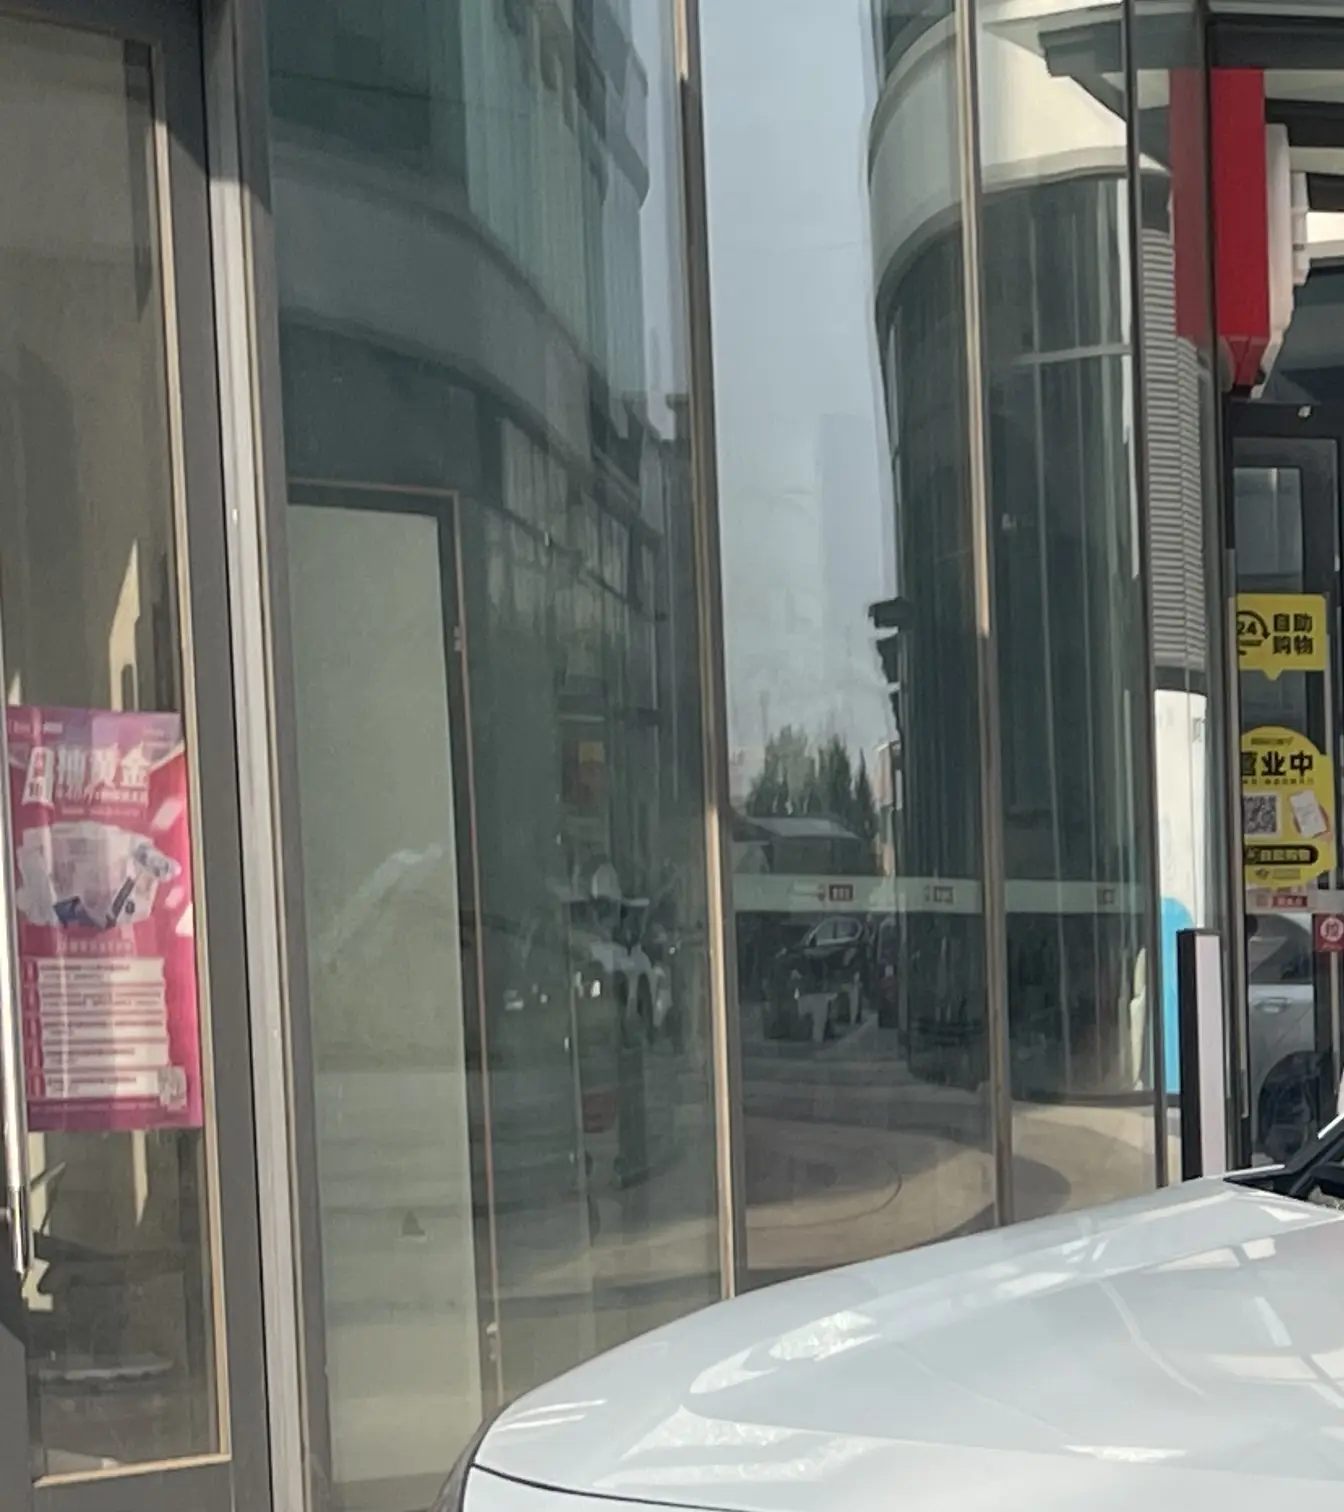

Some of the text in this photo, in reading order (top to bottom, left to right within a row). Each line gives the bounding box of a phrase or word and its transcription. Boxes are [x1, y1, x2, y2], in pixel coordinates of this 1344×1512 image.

[1237, 620, 1257, 635] 24
[1273, 612, 1313, 632] 自助
[1272, 635, 1313, 655] 购物
